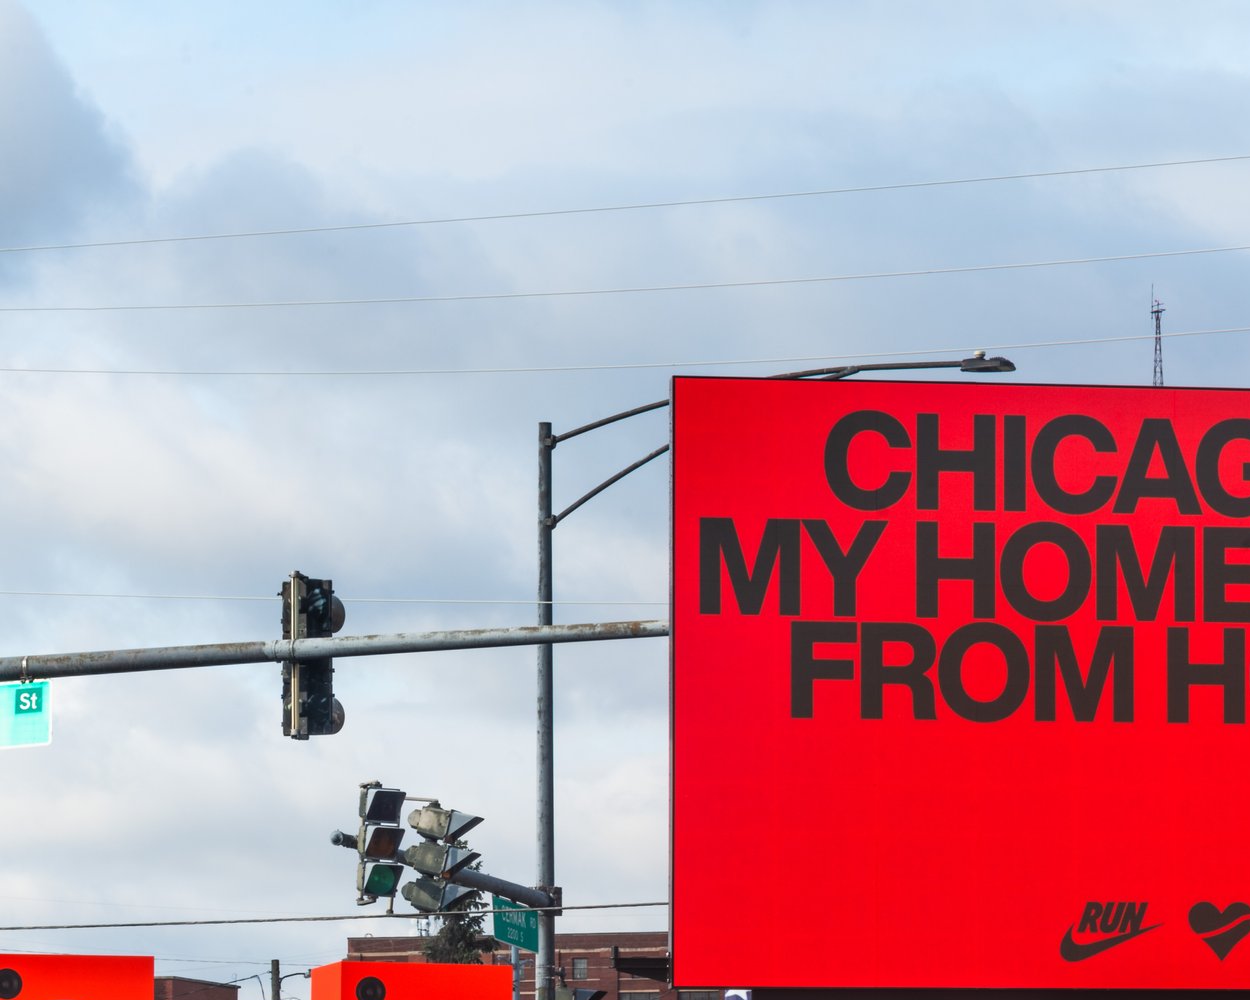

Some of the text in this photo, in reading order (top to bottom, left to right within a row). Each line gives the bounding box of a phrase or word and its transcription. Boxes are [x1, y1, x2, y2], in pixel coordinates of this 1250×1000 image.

[699, 516, 888, 617] MY
[19, 692, 38, 710] St
[790, 621, 1135, 723] FROM
[1077, 901, 1149, 934] RUN
